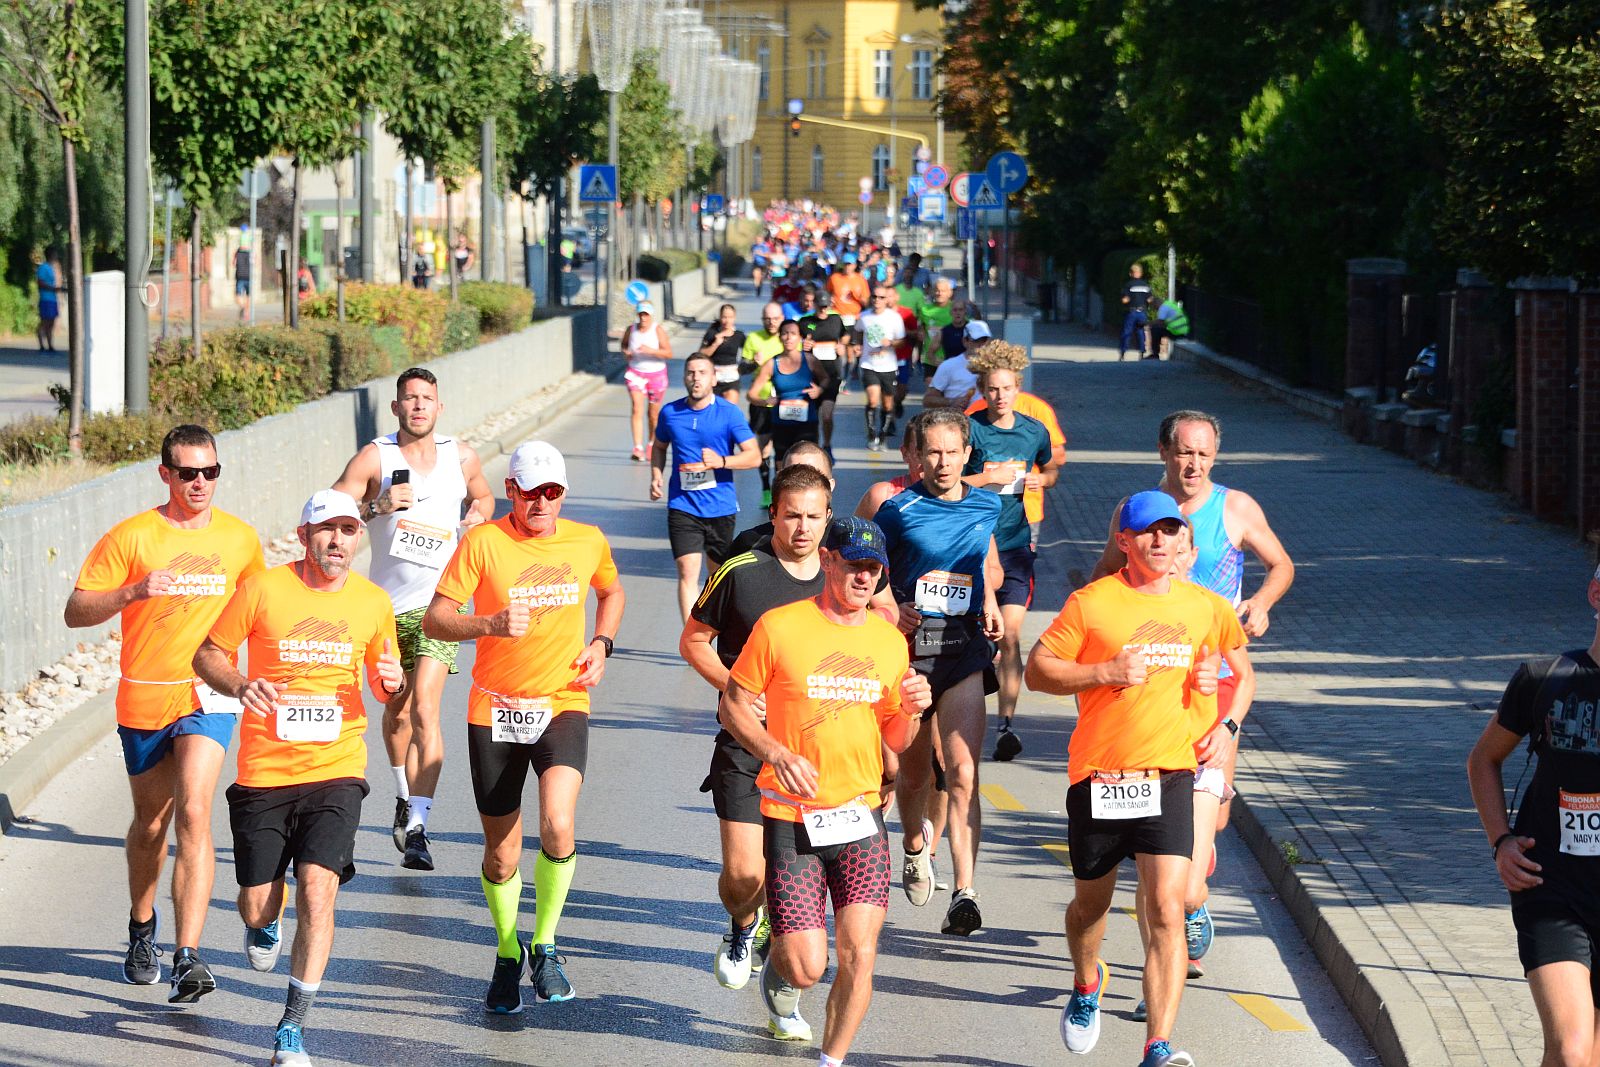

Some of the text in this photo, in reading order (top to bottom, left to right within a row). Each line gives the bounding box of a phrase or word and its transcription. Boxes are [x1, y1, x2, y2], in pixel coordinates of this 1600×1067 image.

[685, 472, 706, 481] 7147
[400, 532, 443, 551] 21037
[161, 574, 227, 585] APATOS
[167, 585, 226, 596] SAPATÁS
[508, 583, 580, 599] CSAPATOS
[922, 583, 967, 600] 14075
[279, 639, 353, 653] CSAPATOS
[279, 651, 352, 664] CSAPATÁS
[1144, 655, 1190, 668] APATÁS
[806, 674, 881, 692] CSAPATOS
[807, 687, 881, 704] CSAPATÁS
[286, 707, 335, 722] 21132
[497, 709, 546, 725] 21067
[1101, 783, 1152, 800] 21108
[1562, 794, 1595, 804] CERBONA
[1573, 833, 1593, 844] NAGY
